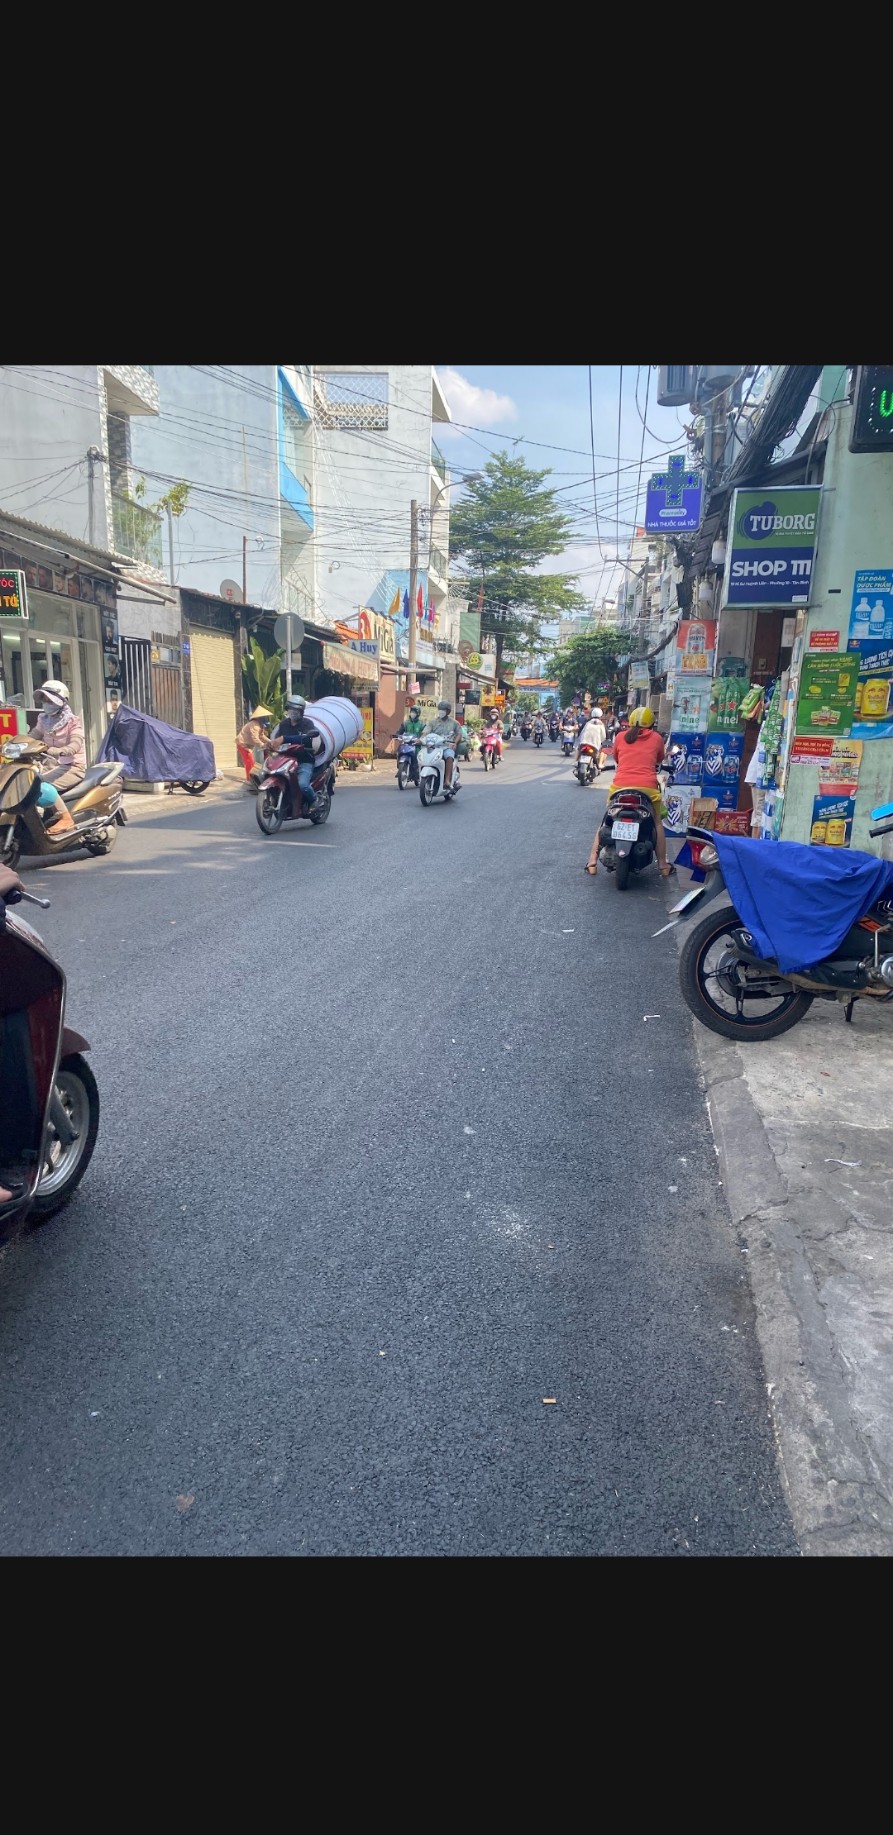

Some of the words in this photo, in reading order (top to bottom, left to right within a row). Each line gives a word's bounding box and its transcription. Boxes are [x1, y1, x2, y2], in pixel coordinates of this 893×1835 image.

[750, 513, 815, 532] TUBORG
[732, 561, 787, 577] SHOP
[791, 560, 811, 576] 111
[360, 641, 377, 654] Huy
